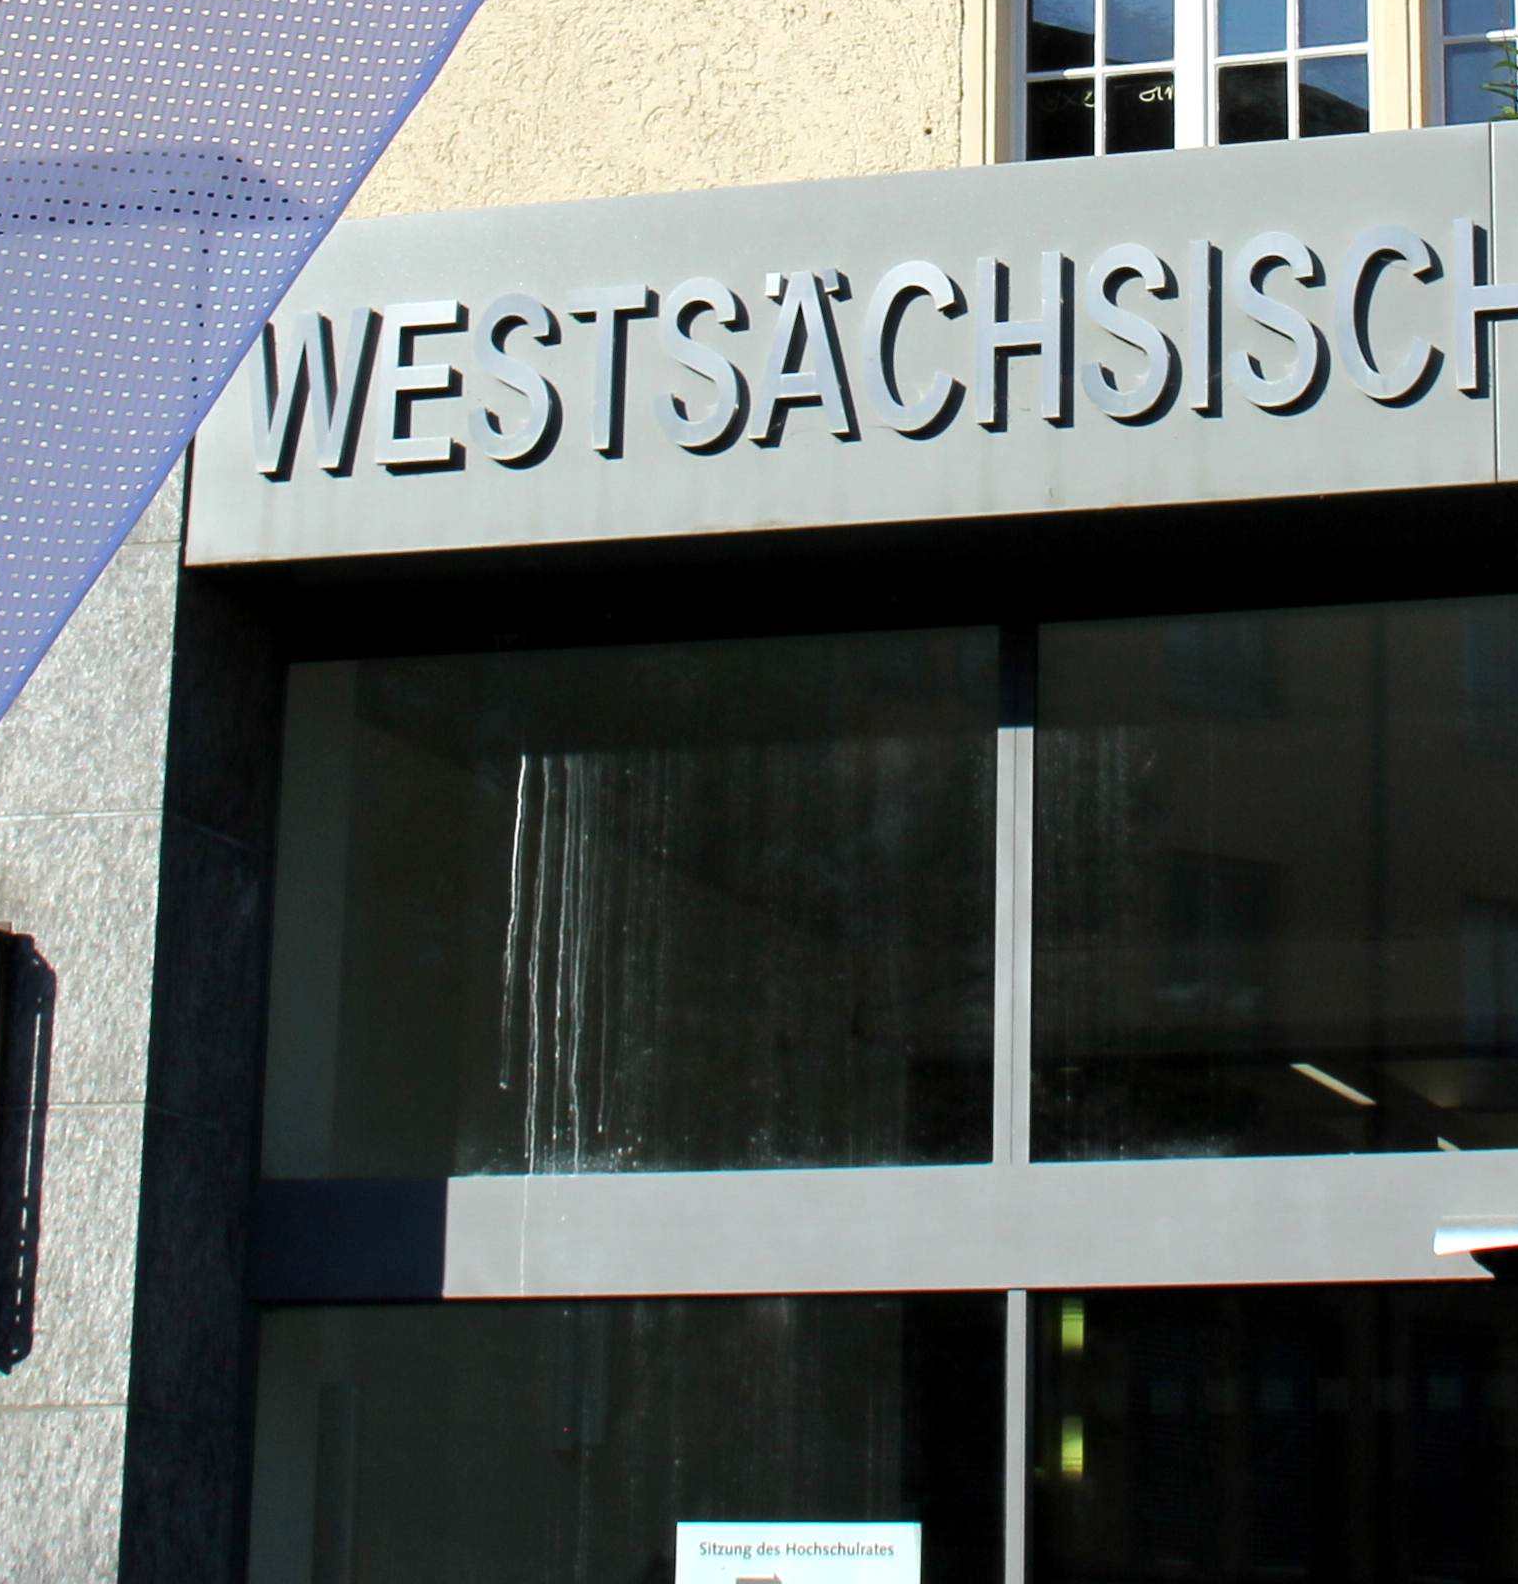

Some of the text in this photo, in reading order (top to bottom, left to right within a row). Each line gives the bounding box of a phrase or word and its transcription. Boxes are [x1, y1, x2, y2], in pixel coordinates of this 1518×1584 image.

[698, 1540, 895, 1560] Sitzung des Hochschulrates
